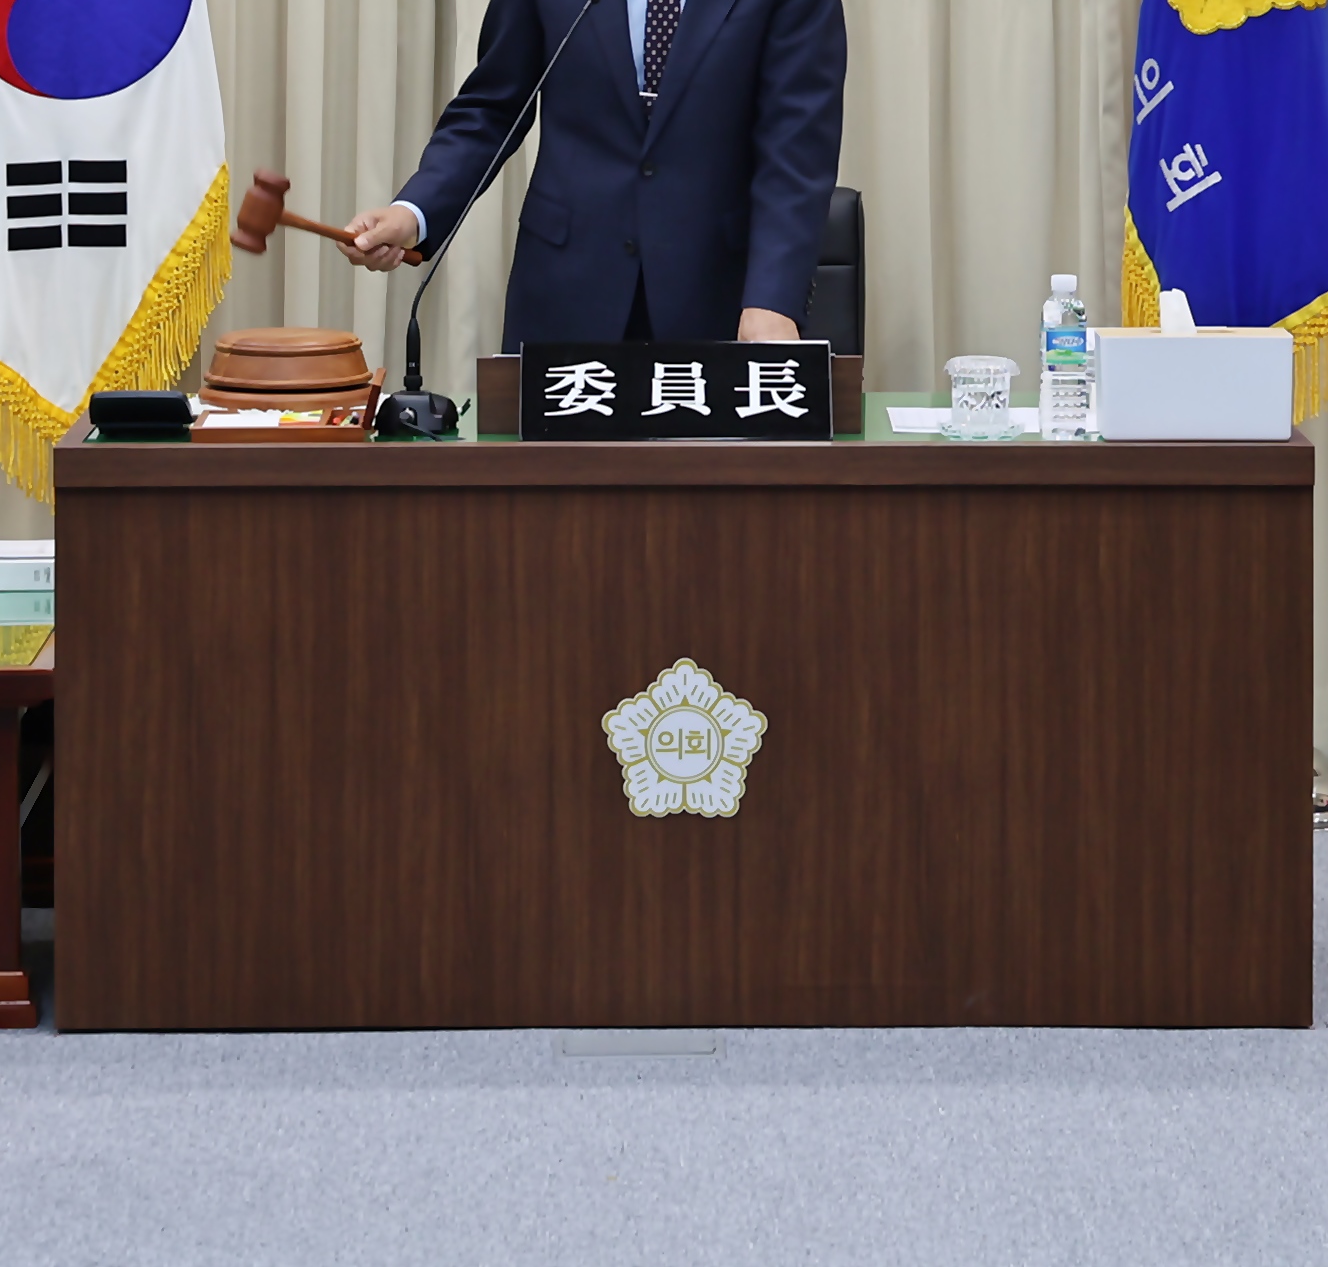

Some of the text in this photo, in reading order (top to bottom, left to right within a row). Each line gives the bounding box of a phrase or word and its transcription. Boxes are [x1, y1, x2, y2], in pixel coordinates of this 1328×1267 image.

[543, 359, 809, 419] 委員長
[655, 728, 712, 761] 의회
